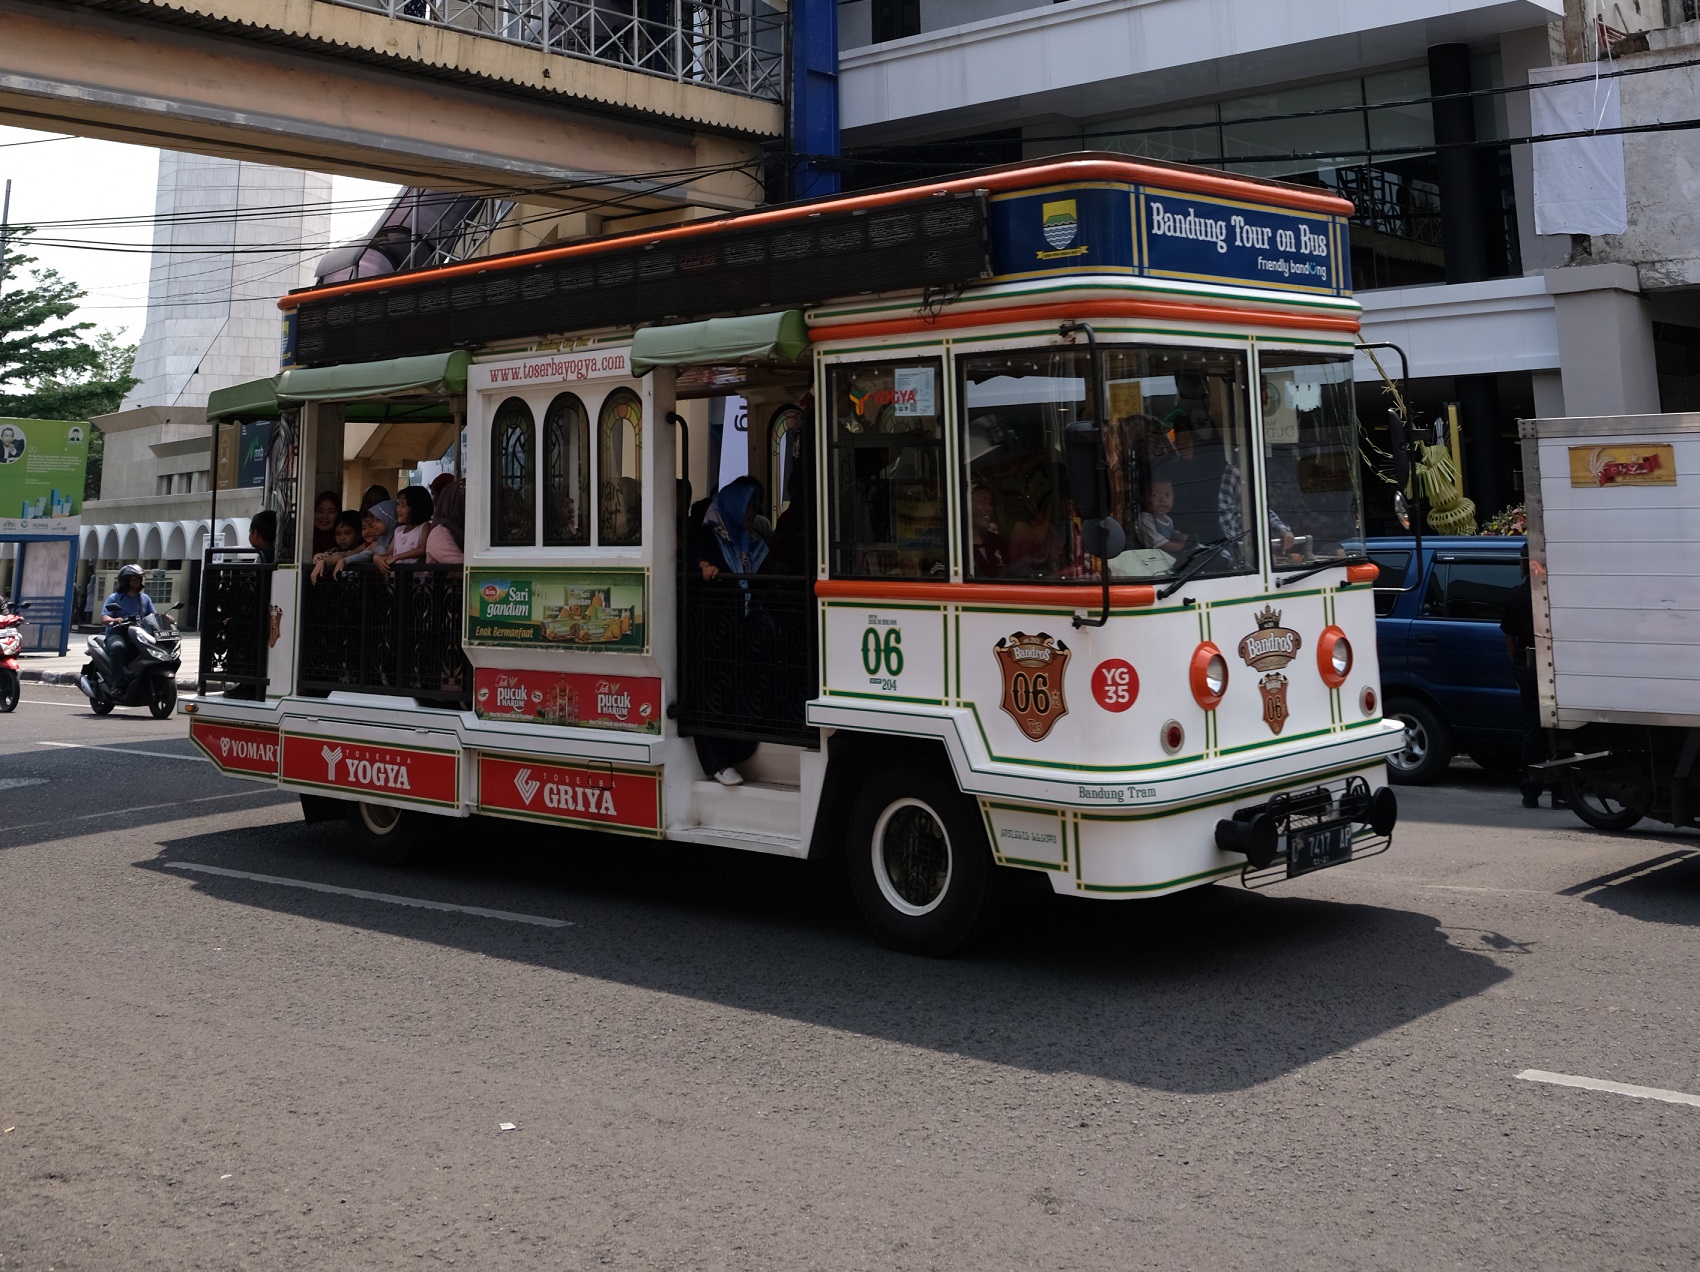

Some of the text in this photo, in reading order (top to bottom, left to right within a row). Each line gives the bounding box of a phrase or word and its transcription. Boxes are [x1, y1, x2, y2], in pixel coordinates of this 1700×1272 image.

[1151, 202, 1327, 256] Bandung Tour on Bus
[1258, 256, 1289, 277] friendly
[490, 355, 625, 382] www.toserbayogya.com
[872, 390, 917, 404] YOGYA
[509, 587, 529, 602] Sari
[486, 603, 529, 617] gandum
[475, 626, 534, 639] Enak Bermanfaat
[861, 627, 904, 677] 06
[1246, 632, 1294, 659] Bandros
[882, 679, 897, 691] 204
[1101, 668, 1130, 685] YG
[497, 685, 528, 706] pucuk
[598, 691, 631, 713] pucuk
[1012, 671, 1050, 715] 06
[1104, 686, 1130, 704] 35
[502, 699, 526, 710] HARUM
[603, 706, 628, 718] HARUM
[1266, 695, 1282, 721] 06
[231, 740, 279, 763] YOMART
[346, 749, 412, 764] TOSERBA
[346, 759, 411, 790] YOGYA
[543, 783, 617, 816] GRIYA
[1079, 786, 1157, 802] Bandung Tram
[1308, 832, 1331, 857] 7417
